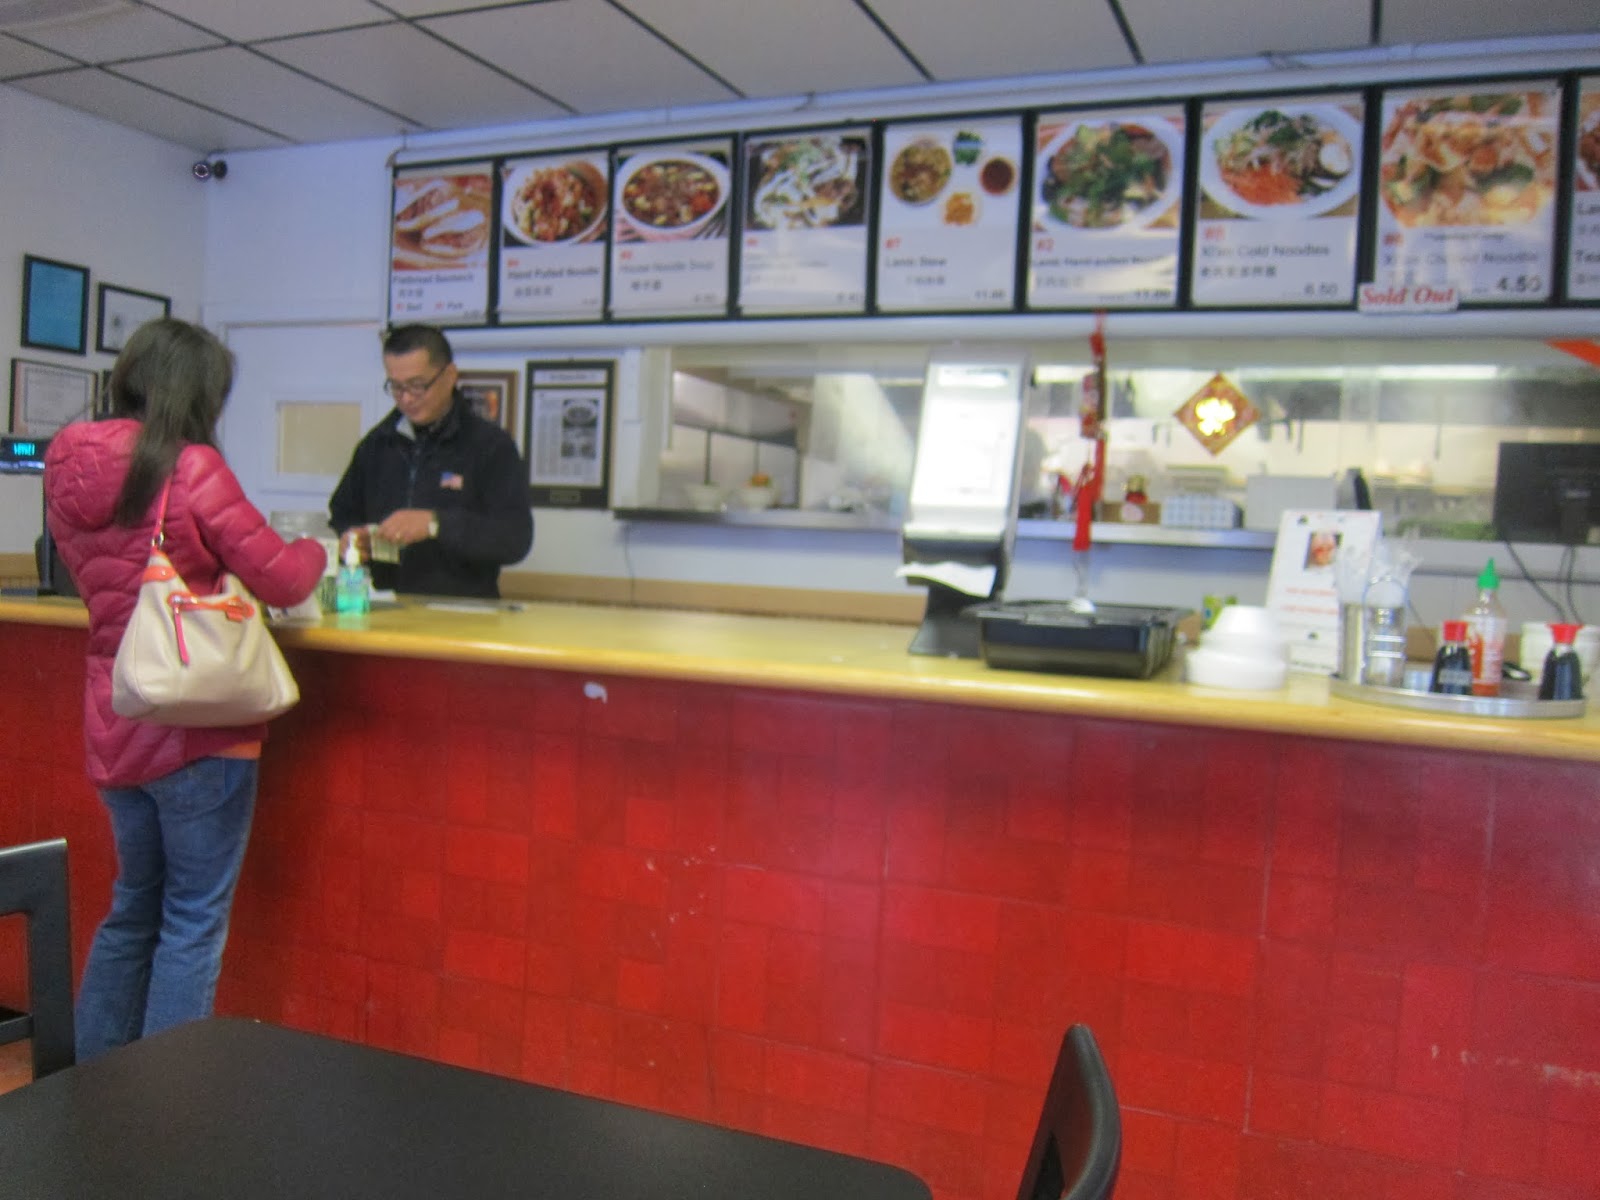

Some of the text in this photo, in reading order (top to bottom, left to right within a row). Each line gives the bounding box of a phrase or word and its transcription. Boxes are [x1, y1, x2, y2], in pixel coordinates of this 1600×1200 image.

[1273, 243, 1330, 257] Noodles
[1362, 285, 1454, 304] Sold Out
